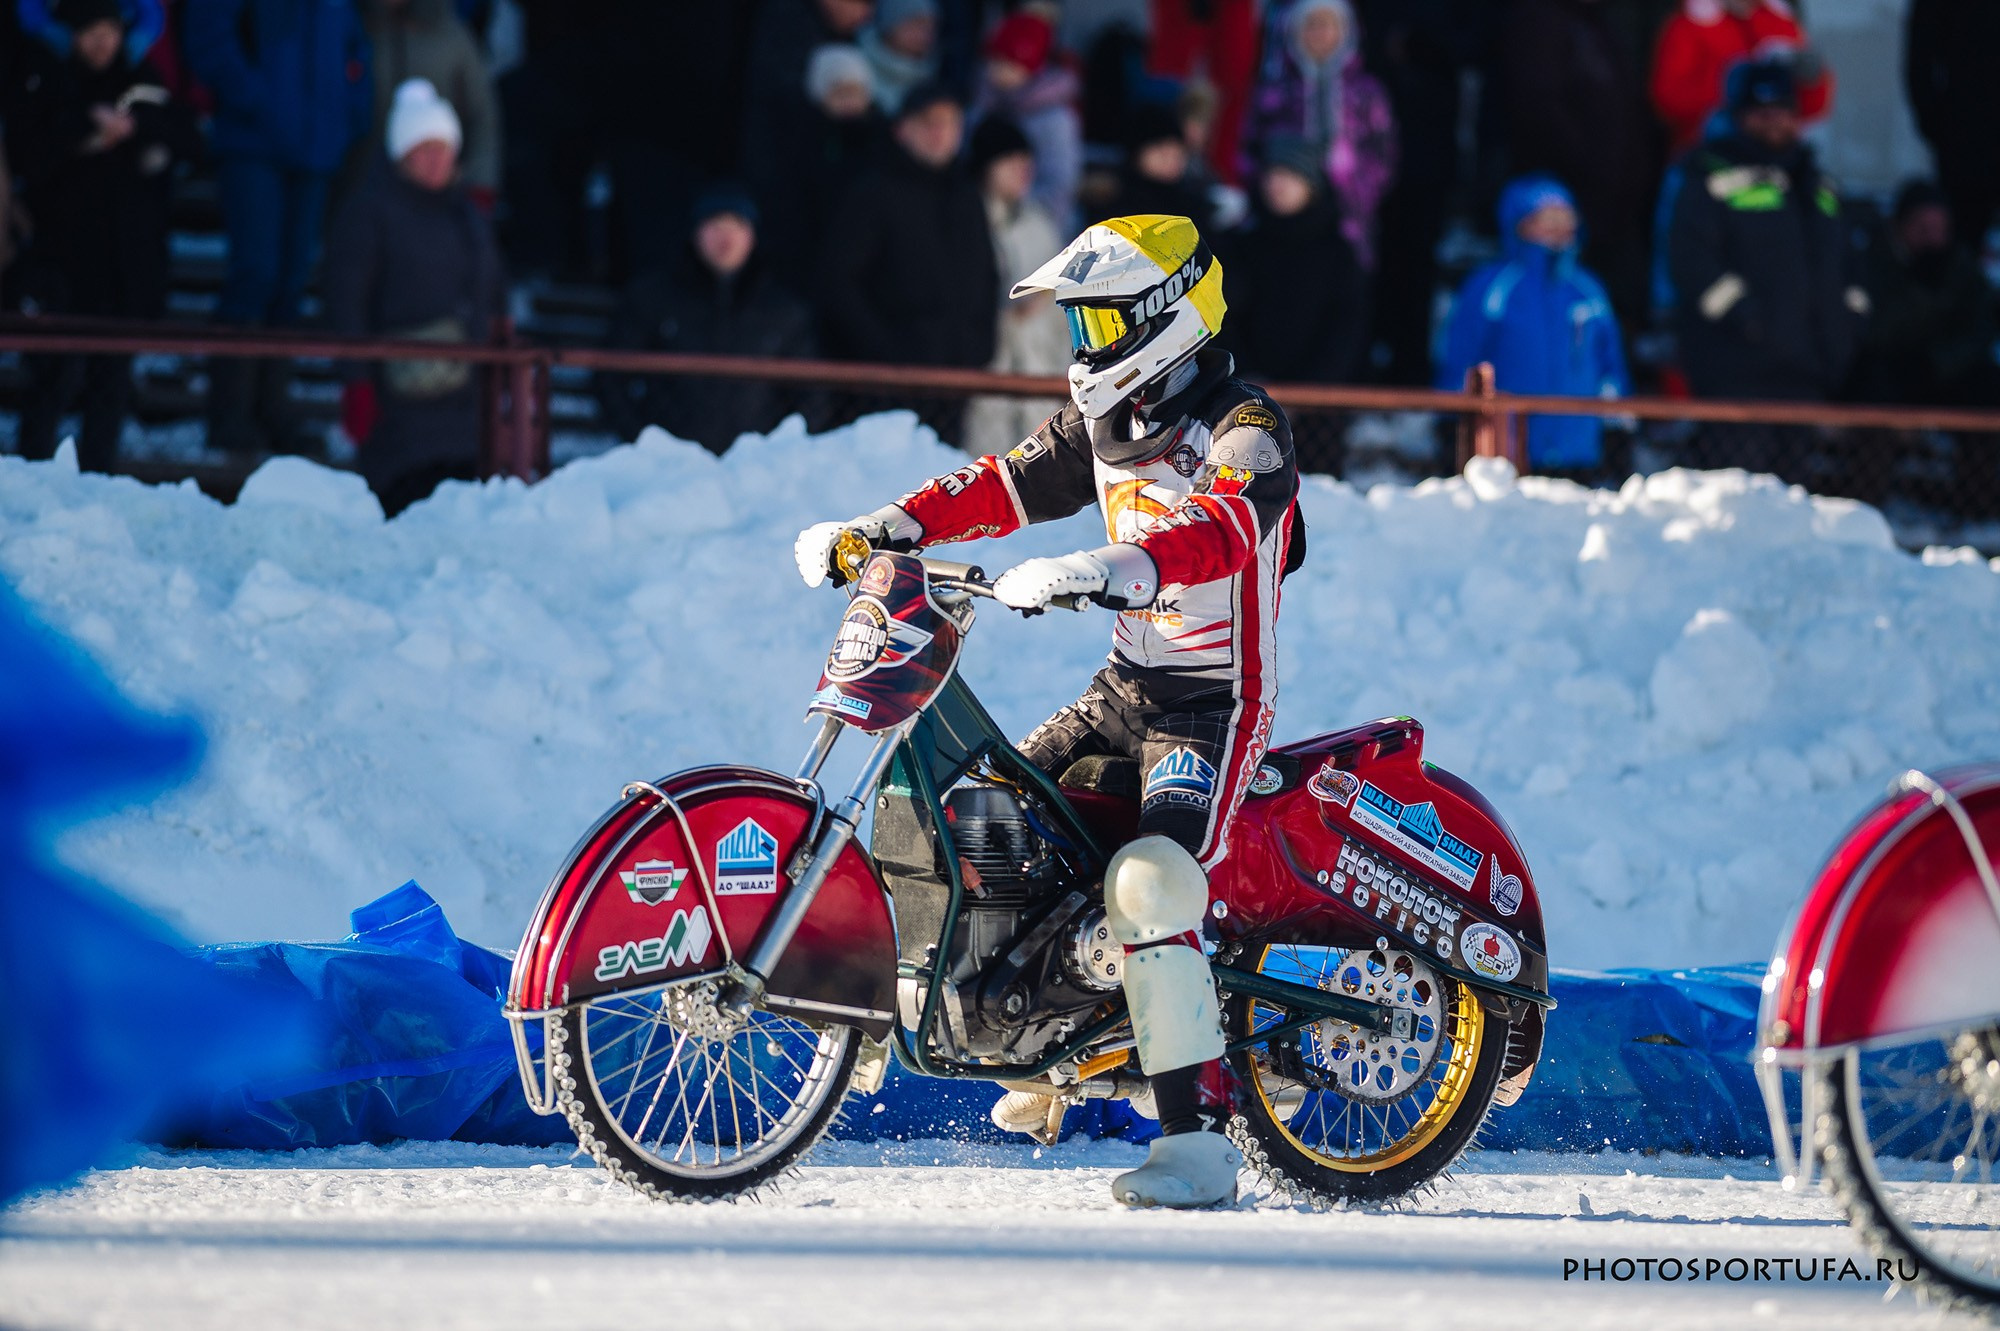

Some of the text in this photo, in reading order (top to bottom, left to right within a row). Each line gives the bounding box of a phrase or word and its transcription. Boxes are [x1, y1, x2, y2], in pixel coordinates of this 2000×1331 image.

[1130, 255, 1203, 327] 100%
[1362, 785, 1400, 816] ШААЗ
[1353, 810, 1363, 819] АО
[1403, 841, 1449, 874] АВТОАГРЕГАТНЫЙ
[1441, 836, 1480, 866] SHAAZ
[718, 880, 775, 891] АО "ШААЗ"
[1330, 871, 1453, 959] SOFICO
[1473, 948, 1506, 975] OSO
